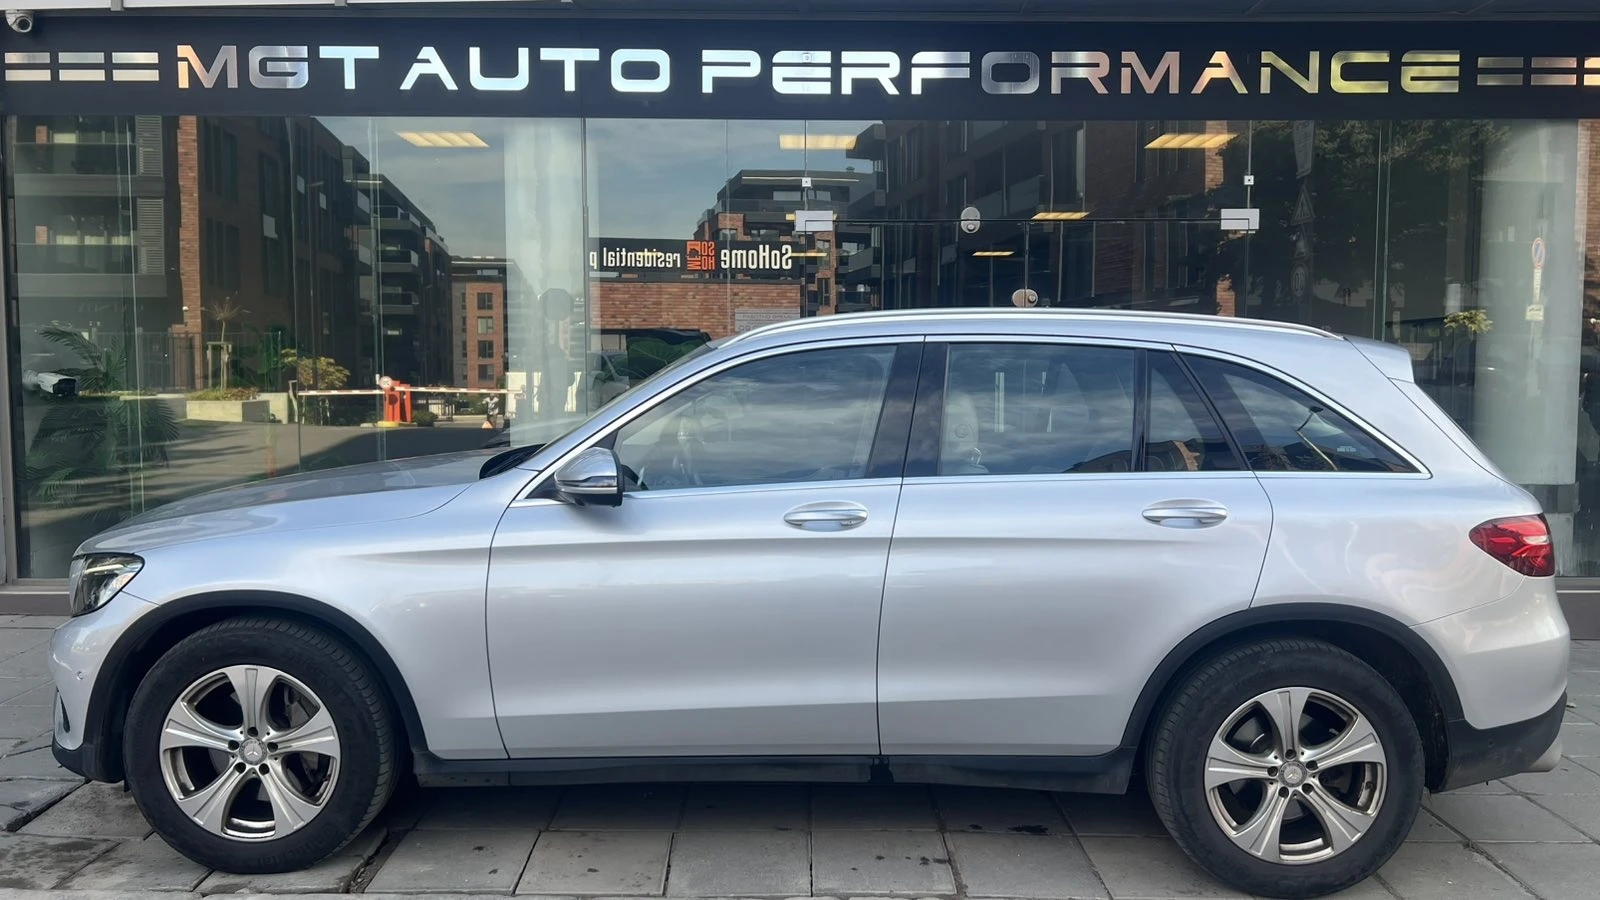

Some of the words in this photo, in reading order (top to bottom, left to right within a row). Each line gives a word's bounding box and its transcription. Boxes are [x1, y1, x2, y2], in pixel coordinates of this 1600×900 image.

[177, 45, 379, 90] MGT
[399, 46, 670, 93] AUTO
[702, 50, 1460, 95] PERFORMANCE
